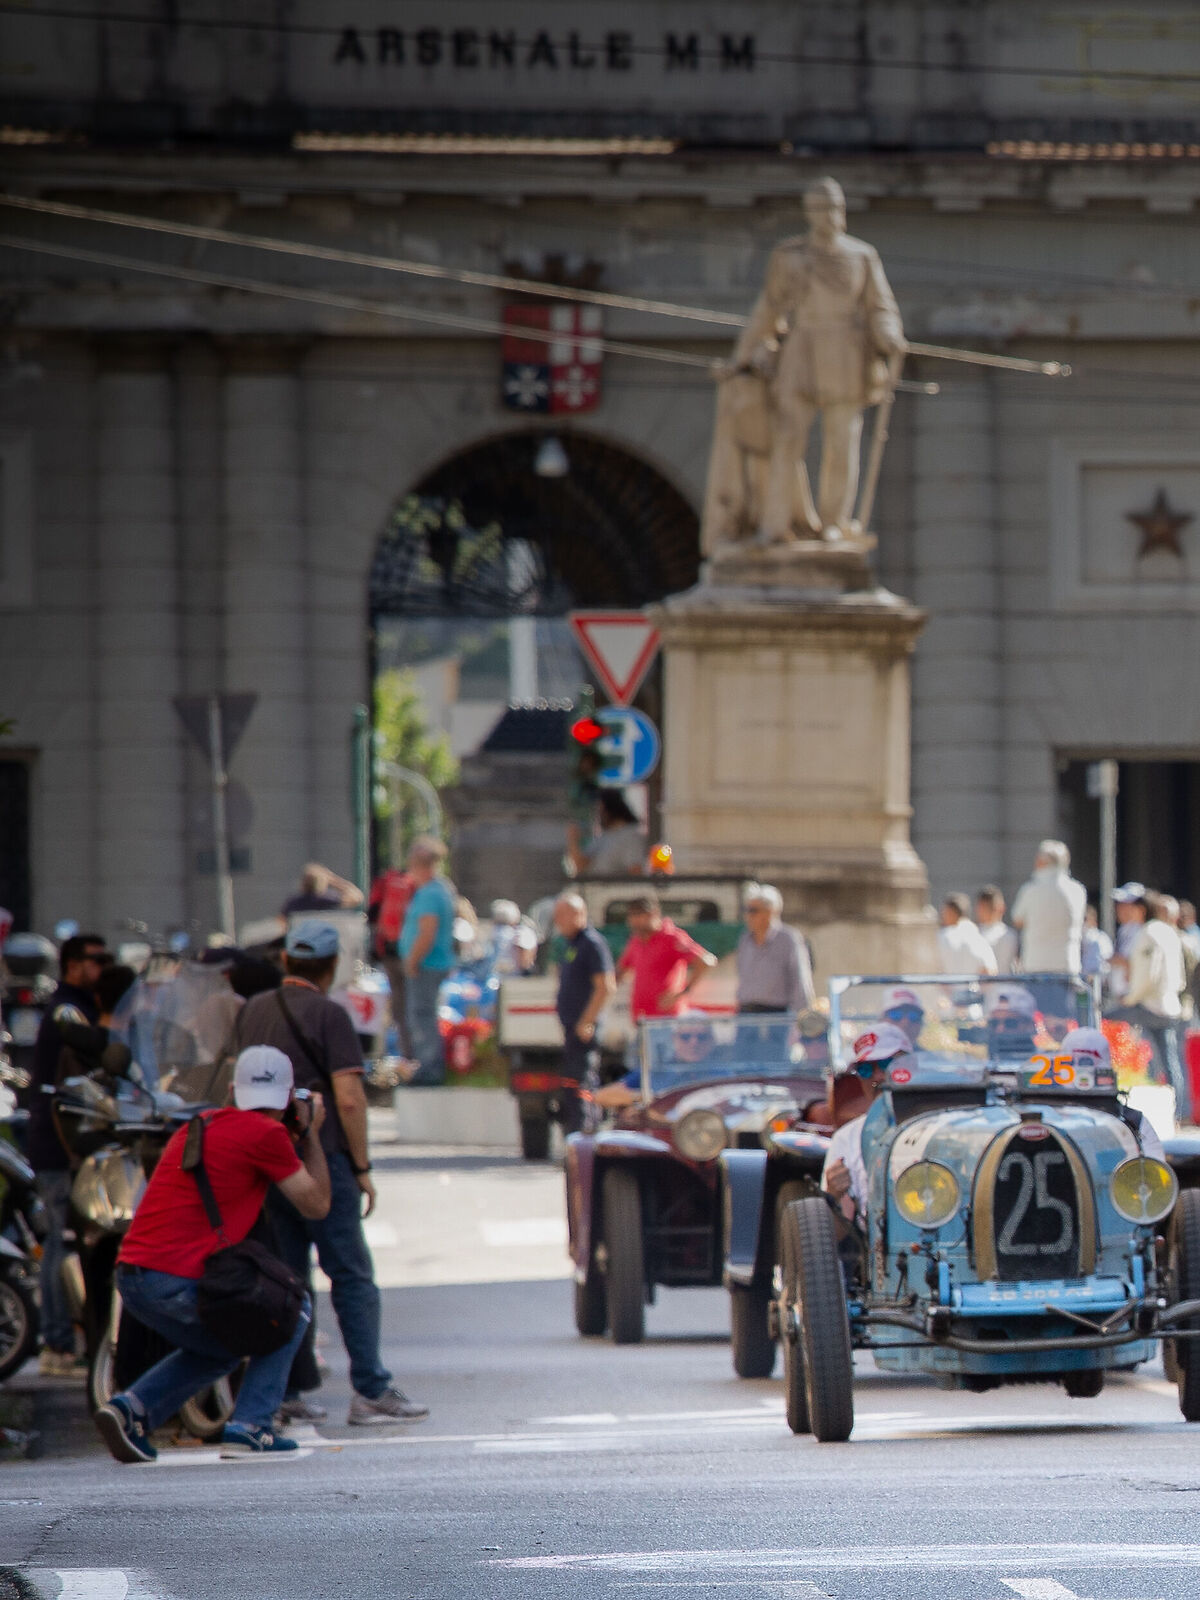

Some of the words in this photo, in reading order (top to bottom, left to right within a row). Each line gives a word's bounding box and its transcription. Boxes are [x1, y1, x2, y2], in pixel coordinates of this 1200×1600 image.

[334, 26, 632, 70] ARSENALE
[663, 31, 699, 72] M
[720, 32, 756, 72] M
[1029, 1055, 1076, 1085] 25
[998, 1151, 1074, 1255] 25
